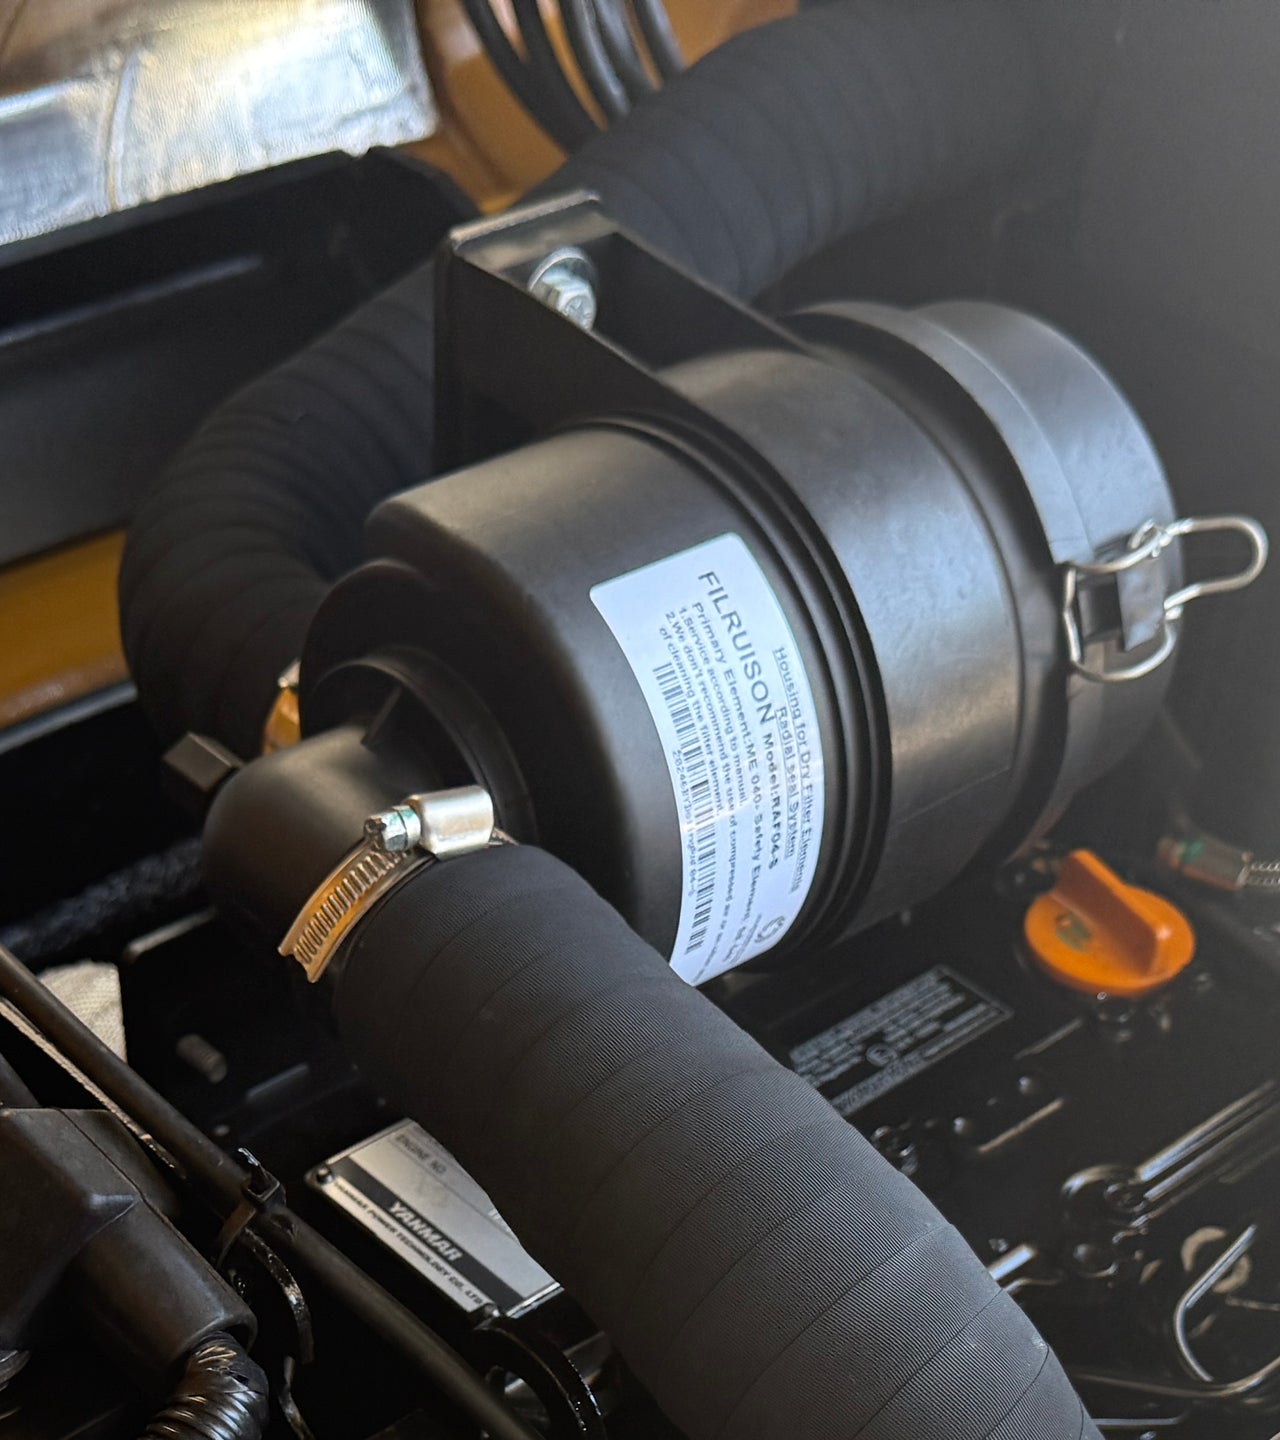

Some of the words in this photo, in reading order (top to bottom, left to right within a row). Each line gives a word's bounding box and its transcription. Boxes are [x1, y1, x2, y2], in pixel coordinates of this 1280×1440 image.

[697, 569, 776, 725] FILRUISON
[664, 610, 687, 642] 2.We
[681, 643, 704, 678] don't
[697, 680, 729, 760] recommend
[677, 606, 712, 665] 1.Service
[705, 666, 734, 734] according
[731, 753, 749, 806] manual.
[772, 645, 802, 719] Housing
[666, 641, 696, 699] cleaning
[691, 700, 704, 722] the
[699, 724, 714, 756] filter
[708, 759, 725, 816] element.
[691, 601, 727, 663] Primary
[750, 813, 764, 860] Safety
[775, 706, 796, 760] Radial
[794, 723, 810, 747] for
[800, 750, 811, 780] Dry
[784, 801, 801, 859] System
[803, 783, 812, 823] Filter
[367, 1208, 398, 1233] POWER
[395, 1231, 448, 1275] TECHNOLOGY
[390, 1201, 463, 1260] YANMAR
